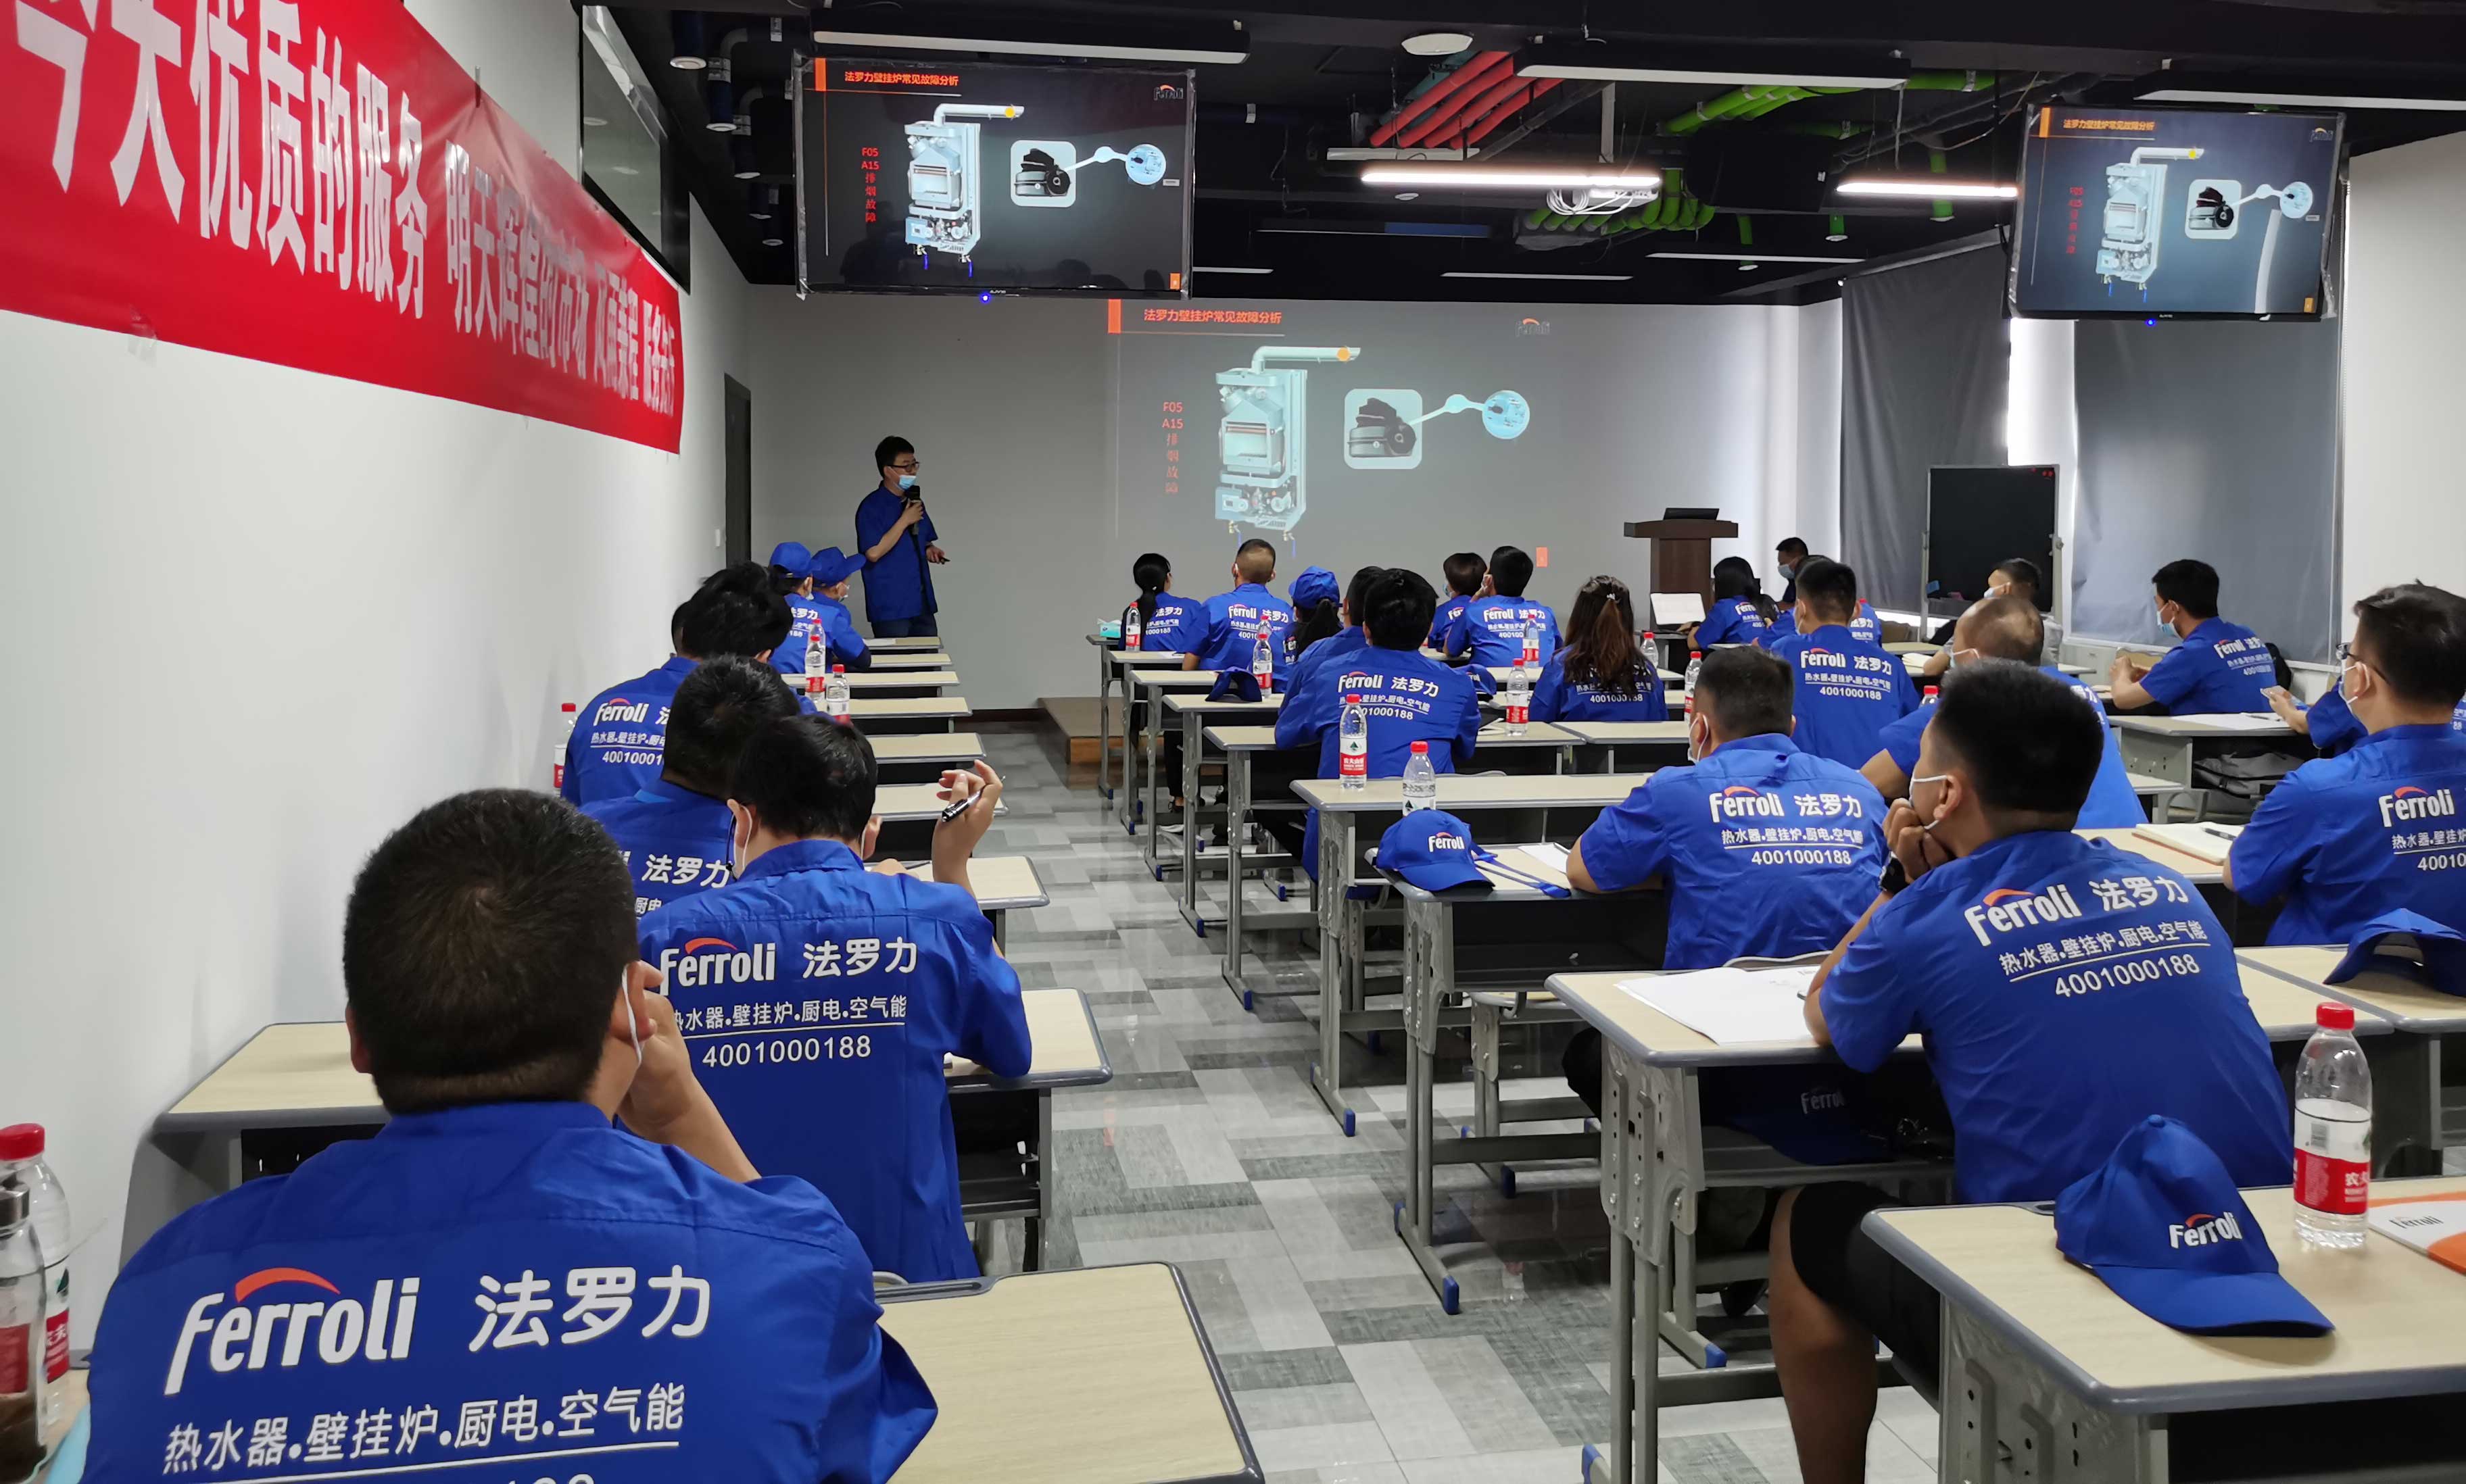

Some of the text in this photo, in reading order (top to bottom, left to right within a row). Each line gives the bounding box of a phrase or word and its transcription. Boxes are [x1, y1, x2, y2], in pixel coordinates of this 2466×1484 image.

[845, 71, 959, 86] 法罗力壁挂炉常见故障分析
[862, 147, 879, 157] F05
[861, 161, 879, 170] A15
[1144, 309, 1282, 324] 法罗力壁挂炉常见故障分析
[1163, 401, 1183, 413] F05
[1162, 418, 1184, 429] A15
[1156, 607, 1182, 617] 法罗力
[1228, 605, 1257, 619] Ferroli
[1483, 609, 1514, 622] Ferroli
[1800, 651, 1892, 675] Ferroli 法罗力
[1338, 674, 1439, 697] Ferroli 法罗力
[1819, 687, 1882, 700] 4001000188
[1590, 693, 1643, 703] 400100088
[593, 702, 650, 726] Ferroli
[602, 751, 663, 765] 40010001
[1709, 792, 1862, 823] Ferroli 法罗力
[2378, 789, 2455, 828] Ferroli
[1428, 835, 1465, 852] Ferroli
[1751, 850, 1852, 865] 4001000188
[2417, 853, 2466, 871] 40010
[642, 854, 732, 888] 法罗力
[1964, 875, 2189, 946] Ferroli 法罗力
[659, 936, 917, 996] Ferroli 法罗力
[2055, 954, 2201, 997] 4001000188
[702, 1035, 871, 1068] 4001000188
[2169, 1212, 2242, 1249] Ferroli
[164, 1265, 711, 1396] Ferroli 法罗力
